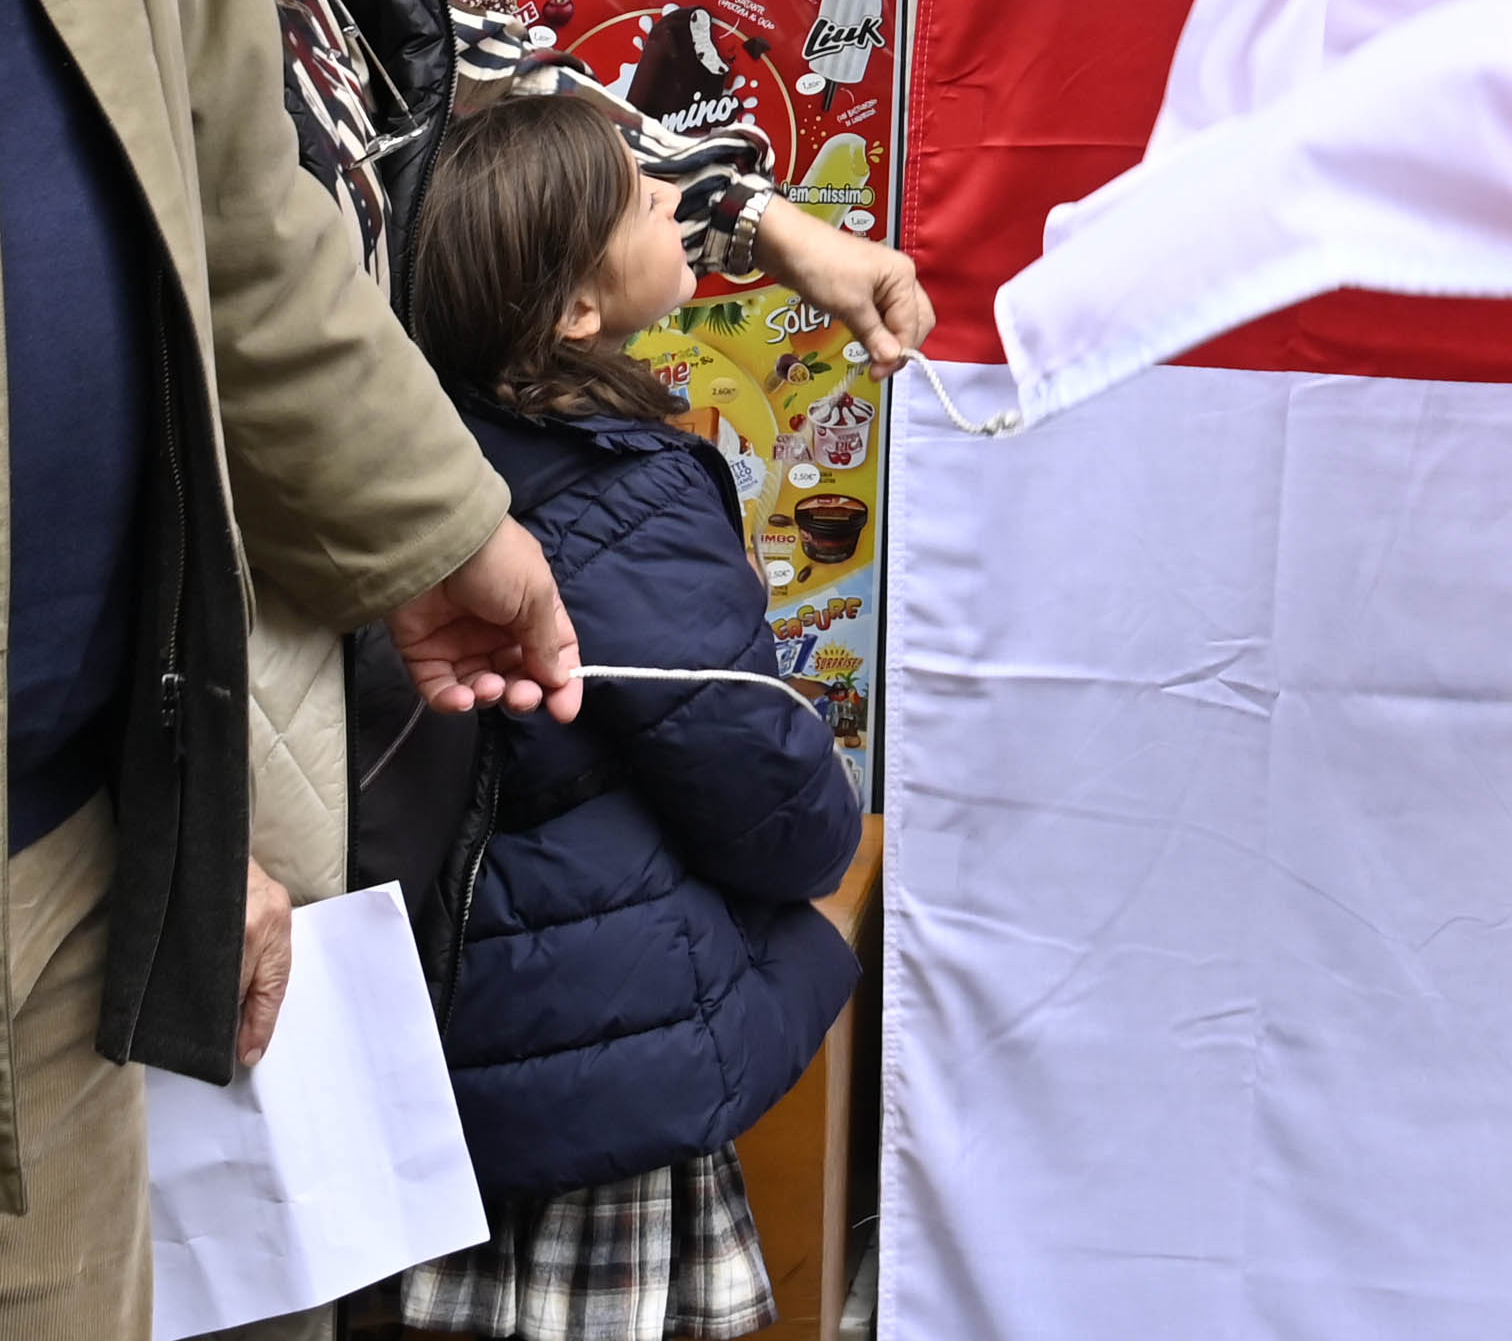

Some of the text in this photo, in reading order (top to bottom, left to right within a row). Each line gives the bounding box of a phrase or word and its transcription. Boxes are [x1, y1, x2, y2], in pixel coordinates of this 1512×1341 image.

[660, 91, 739, 134] mino
[731, 460, 745, 471] TTE
[771, 597, 863, 640] EASURE
